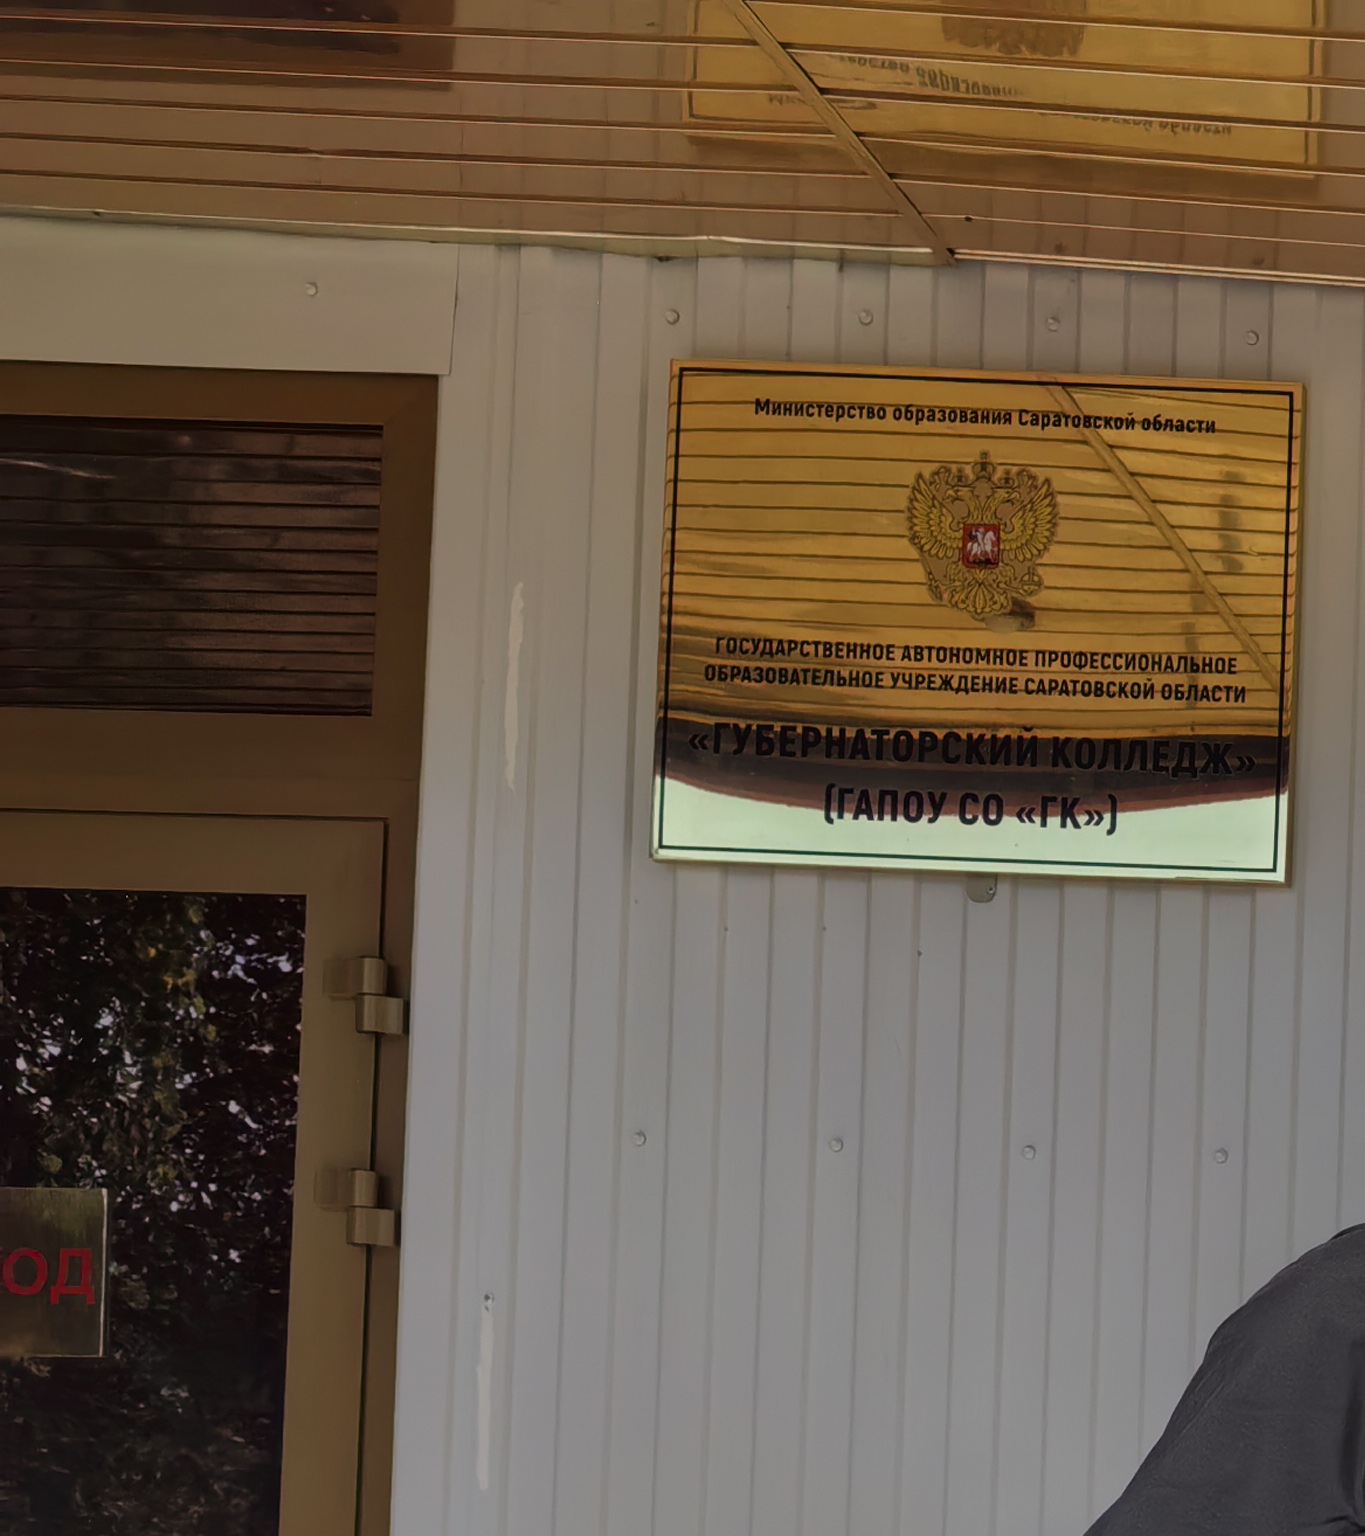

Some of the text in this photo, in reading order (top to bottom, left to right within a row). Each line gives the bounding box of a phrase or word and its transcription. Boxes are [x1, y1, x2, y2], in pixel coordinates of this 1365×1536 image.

[754, 398, 1216, 434] Министерство образования Саратовской области
[715, 637, 1238, 675] ГОСУДАРСТВЕННОЕ АВТОНОМНОЕ ПРОФЕССИОНАЛЬНОЕ
[704, 665, 1246, 704] ОБРАЗОВАТЕЛЬНОЕ УЧРЕЖДЕНИЕ САРАТОВСКОЙ ОБЛАСТИ
[688, 721, 1257, 778] «ГУБЕРНАТОРСКИЙ КОЛЛЕДЖ»
[824, 782, 1119, 836] (ГАПОУ СО «ГК»)
[0, 1247, 95, 1305] ОД
